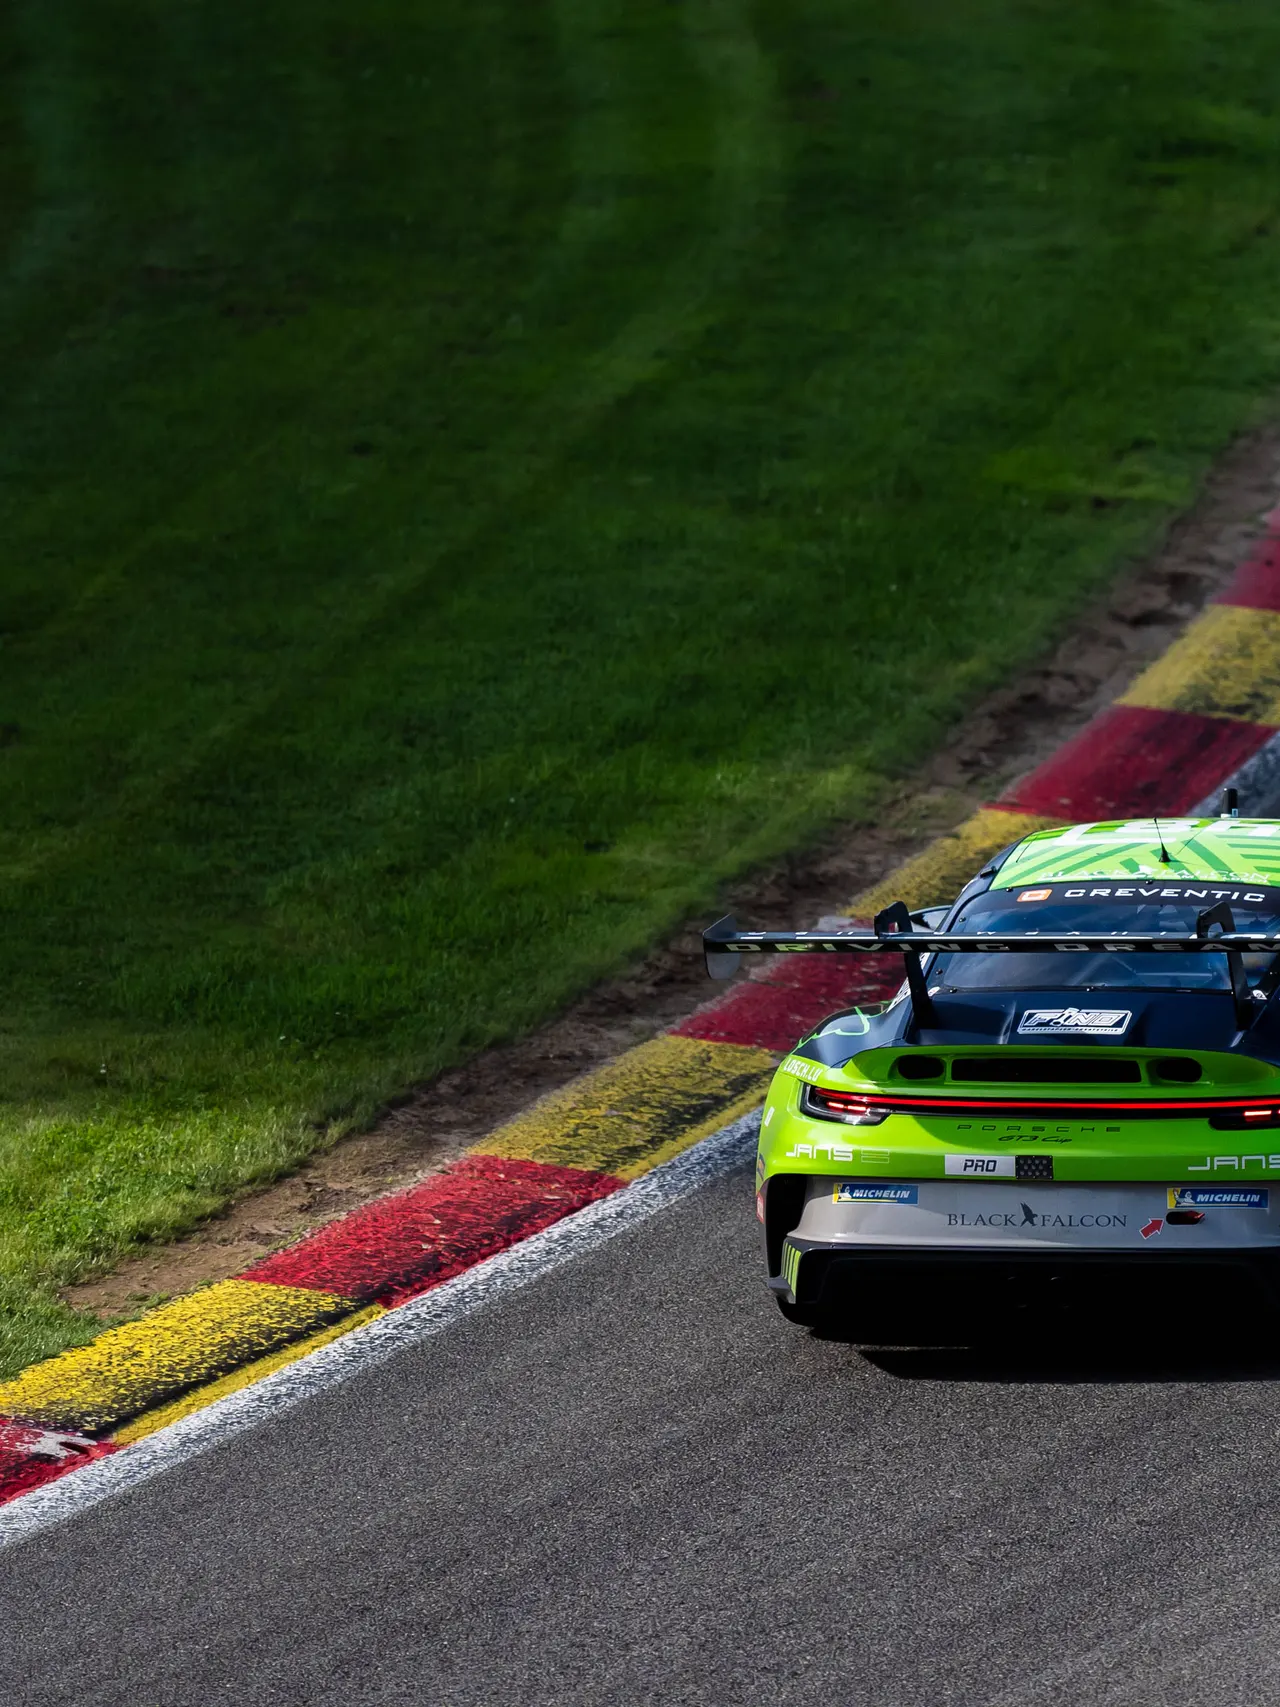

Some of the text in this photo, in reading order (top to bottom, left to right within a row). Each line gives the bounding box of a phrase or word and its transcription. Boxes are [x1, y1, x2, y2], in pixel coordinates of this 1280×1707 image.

[1064, 888, 1265, 902] CREVENTIC
[725, 942, 1011, 952] DRIVING
[784, 1058, 821, 1082] LOSCH.LU
[957, 1124, 1121, 1133] PORSCHE
[1041, 1135, 1072, 1144] Cup
[962, 1159, 997, 1173] PRO
[853, 1189, 911, 1199] MICHELIN
[1196, 1192, 1261, 1203] MICHELIN
[947, 1213, 1128, 1228] BLACK FALCON
